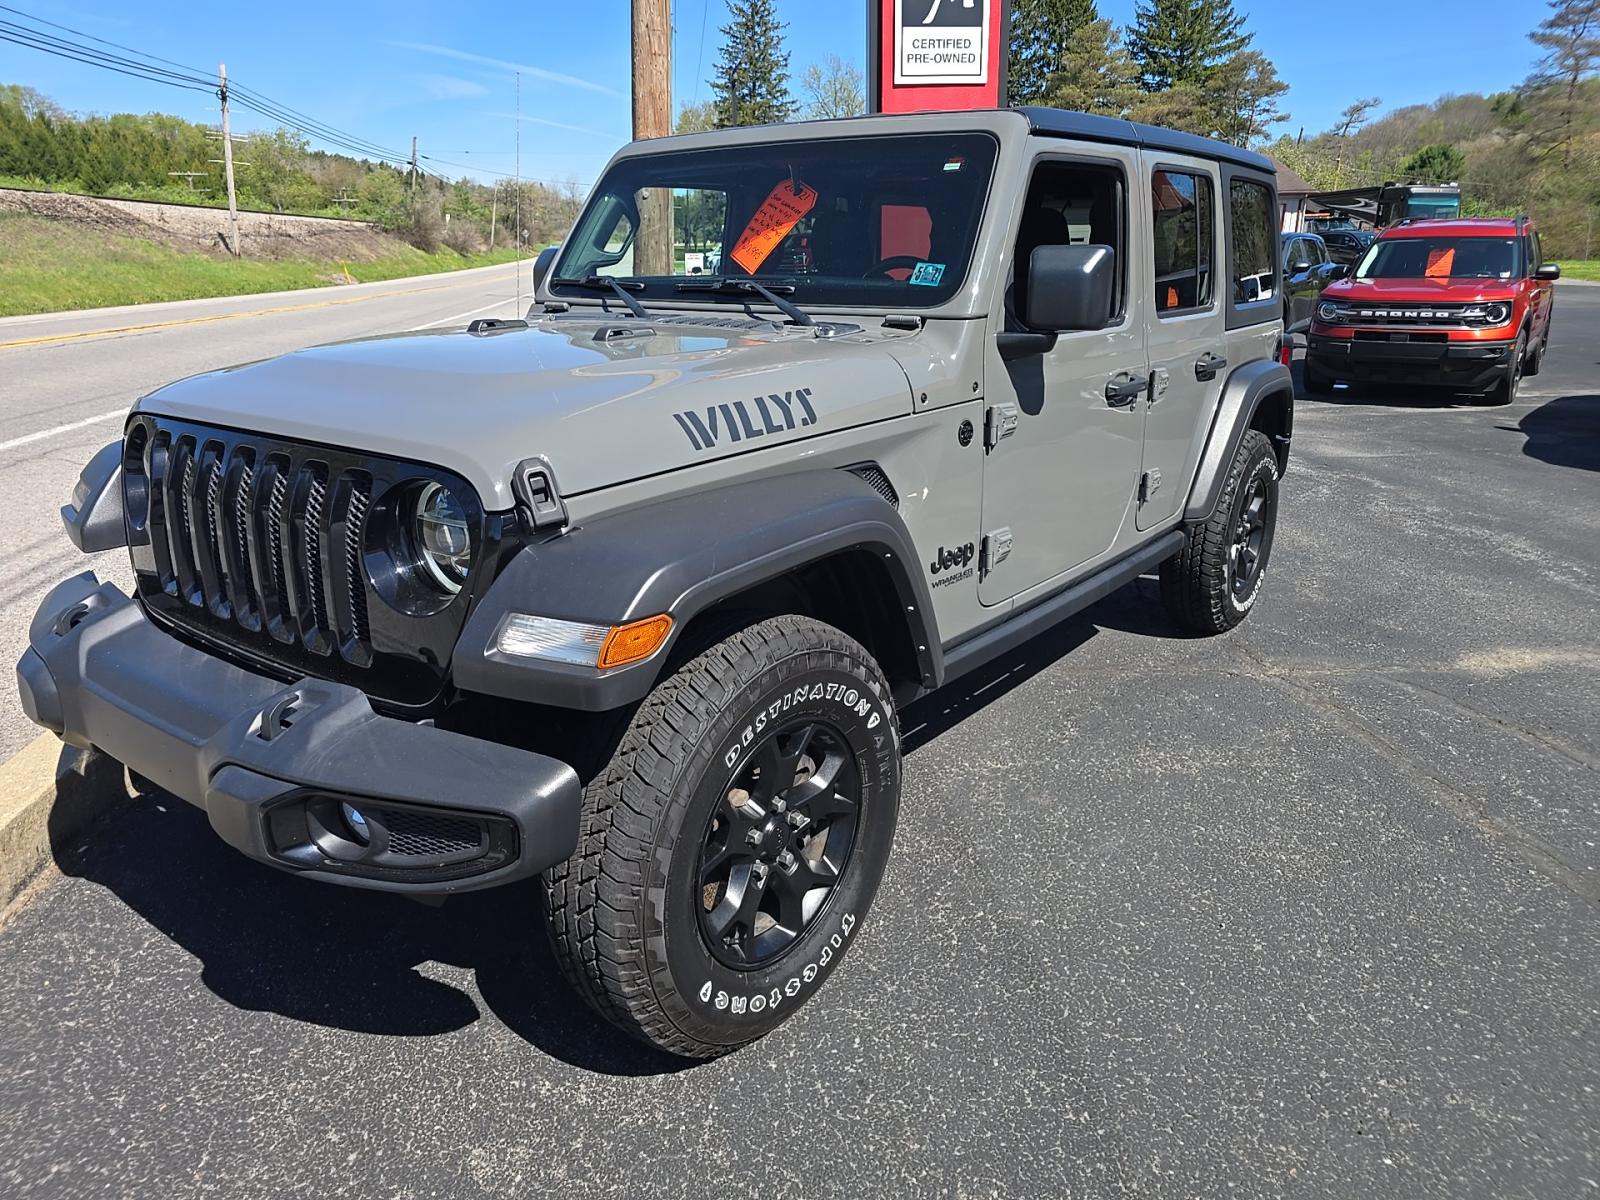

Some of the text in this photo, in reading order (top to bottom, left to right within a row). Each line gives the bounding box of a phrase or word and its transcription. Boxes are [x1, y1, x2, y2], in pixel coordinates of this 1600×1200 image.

[912, 39, 972, 49] CERTIFIED
[907, 53, 976, 64] PRE-OWNED
[1360, 310, 1450, 318] BRONCO
[672, 387, 818, 451] WILLYS
[930, 542, 975, 575] Jeep
[931, 567, 973, 588] WRANGLER
[724, 682, 872, 769] DESTINATION
